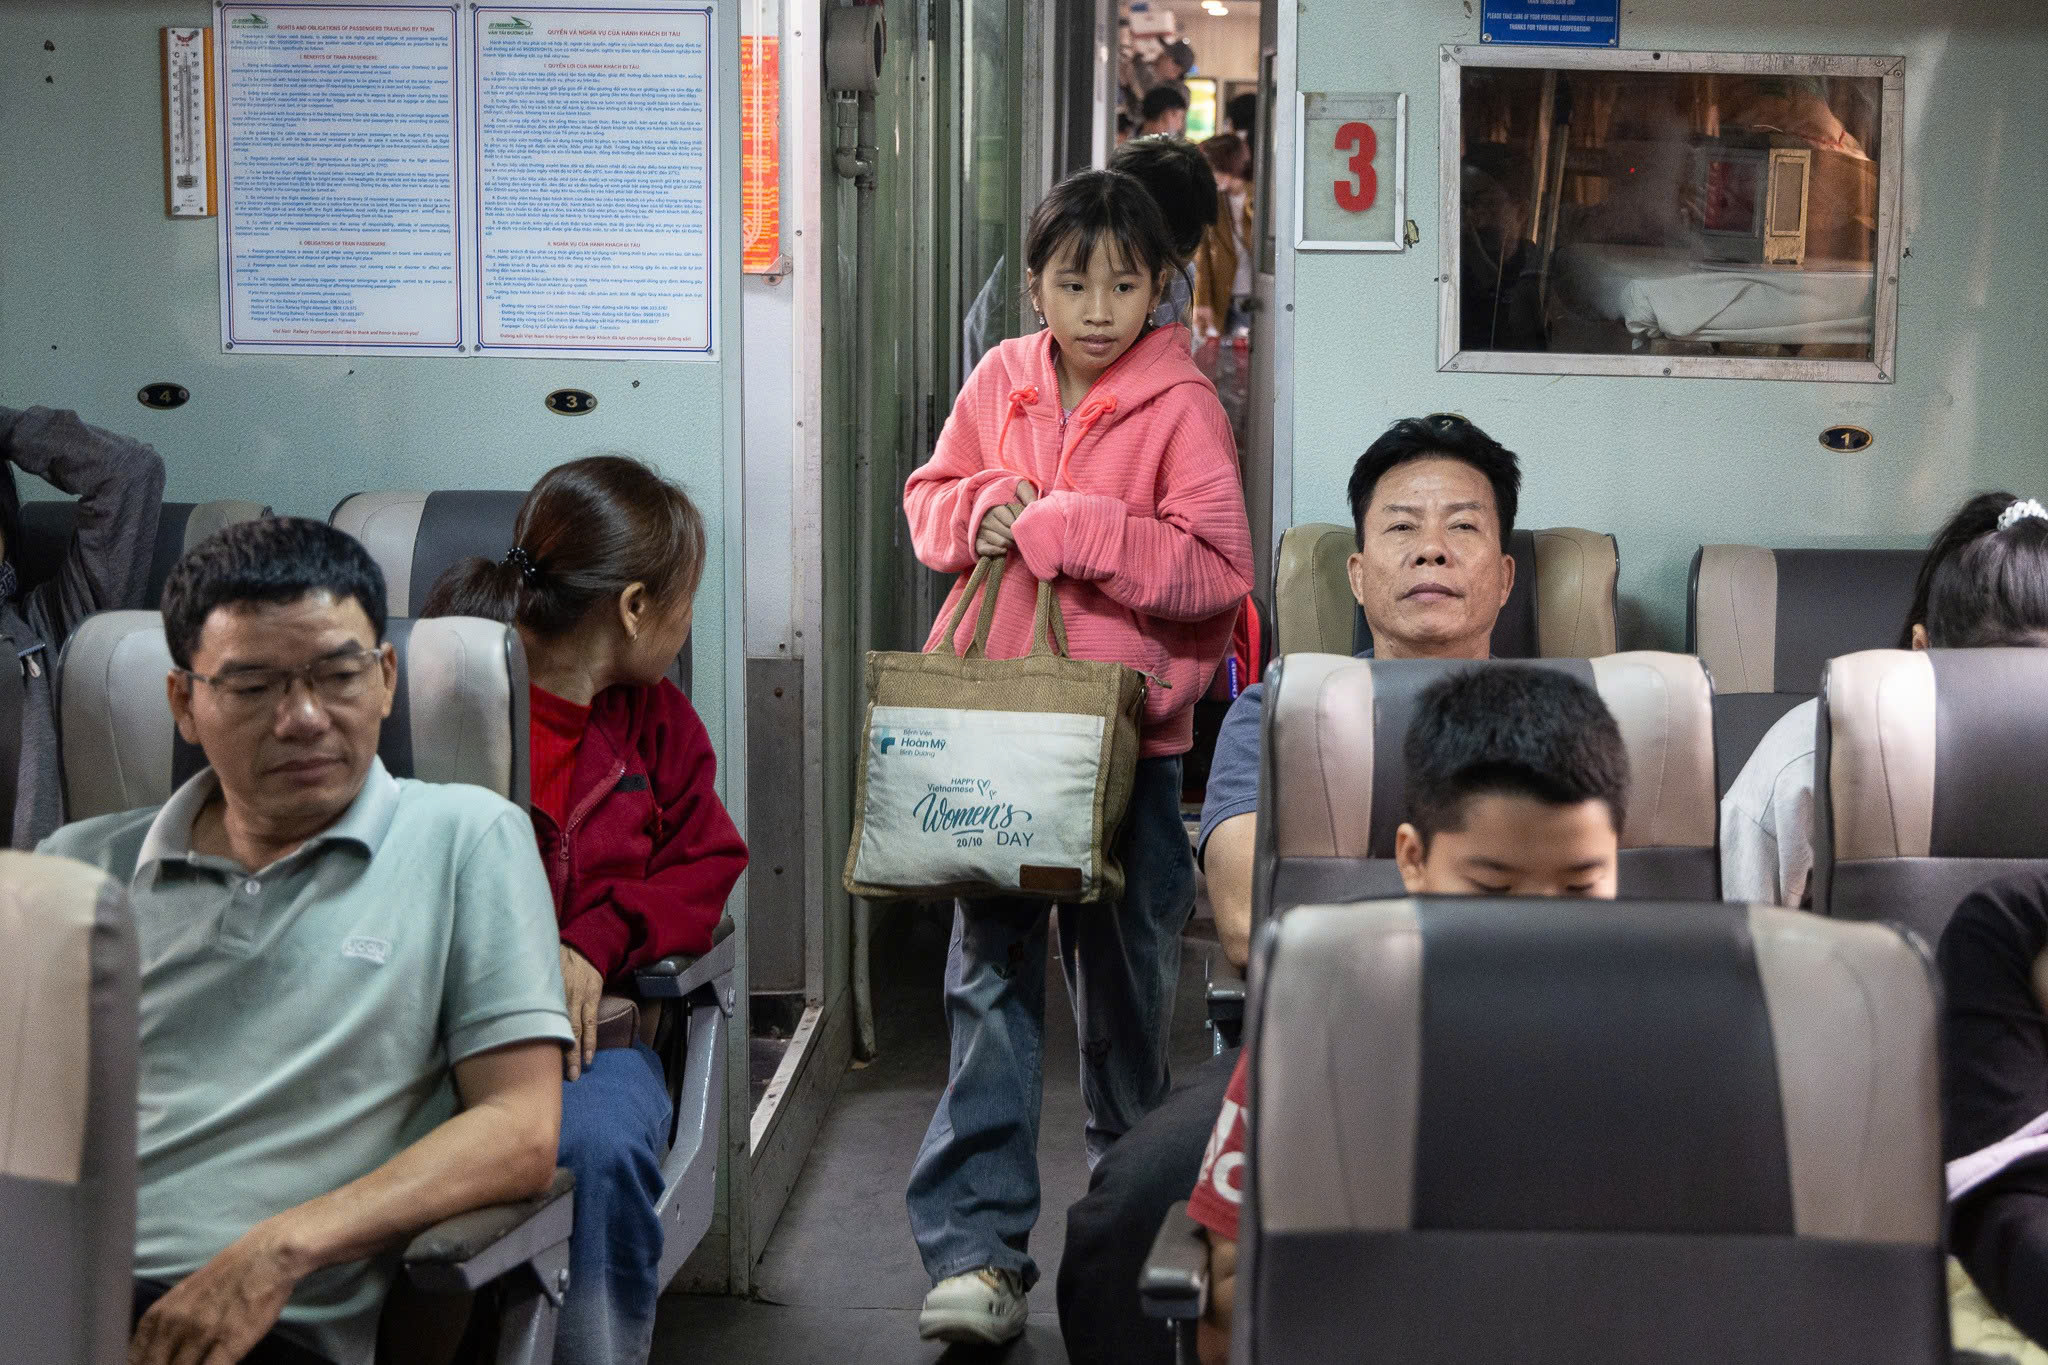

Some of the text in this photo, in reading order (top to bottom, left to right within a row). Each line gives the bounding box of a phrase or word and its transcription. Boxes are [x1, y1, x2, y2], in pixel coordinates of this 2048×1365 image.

[1334, 122, 1377, 212] 3
[160, 390, 170, 402] 4
[566, 396, 577, 408] 3
[1841, 432, 1850, 447] 1
[901, 737, 946, 750] Hoàn Mỹ
[914, 749, 935, 758] Dương
[927, 784, 974, 793] Vietnamese
[913, 793, 1032, 832] Women's
[957, 831, 1034, 848] 20/10 DAY
